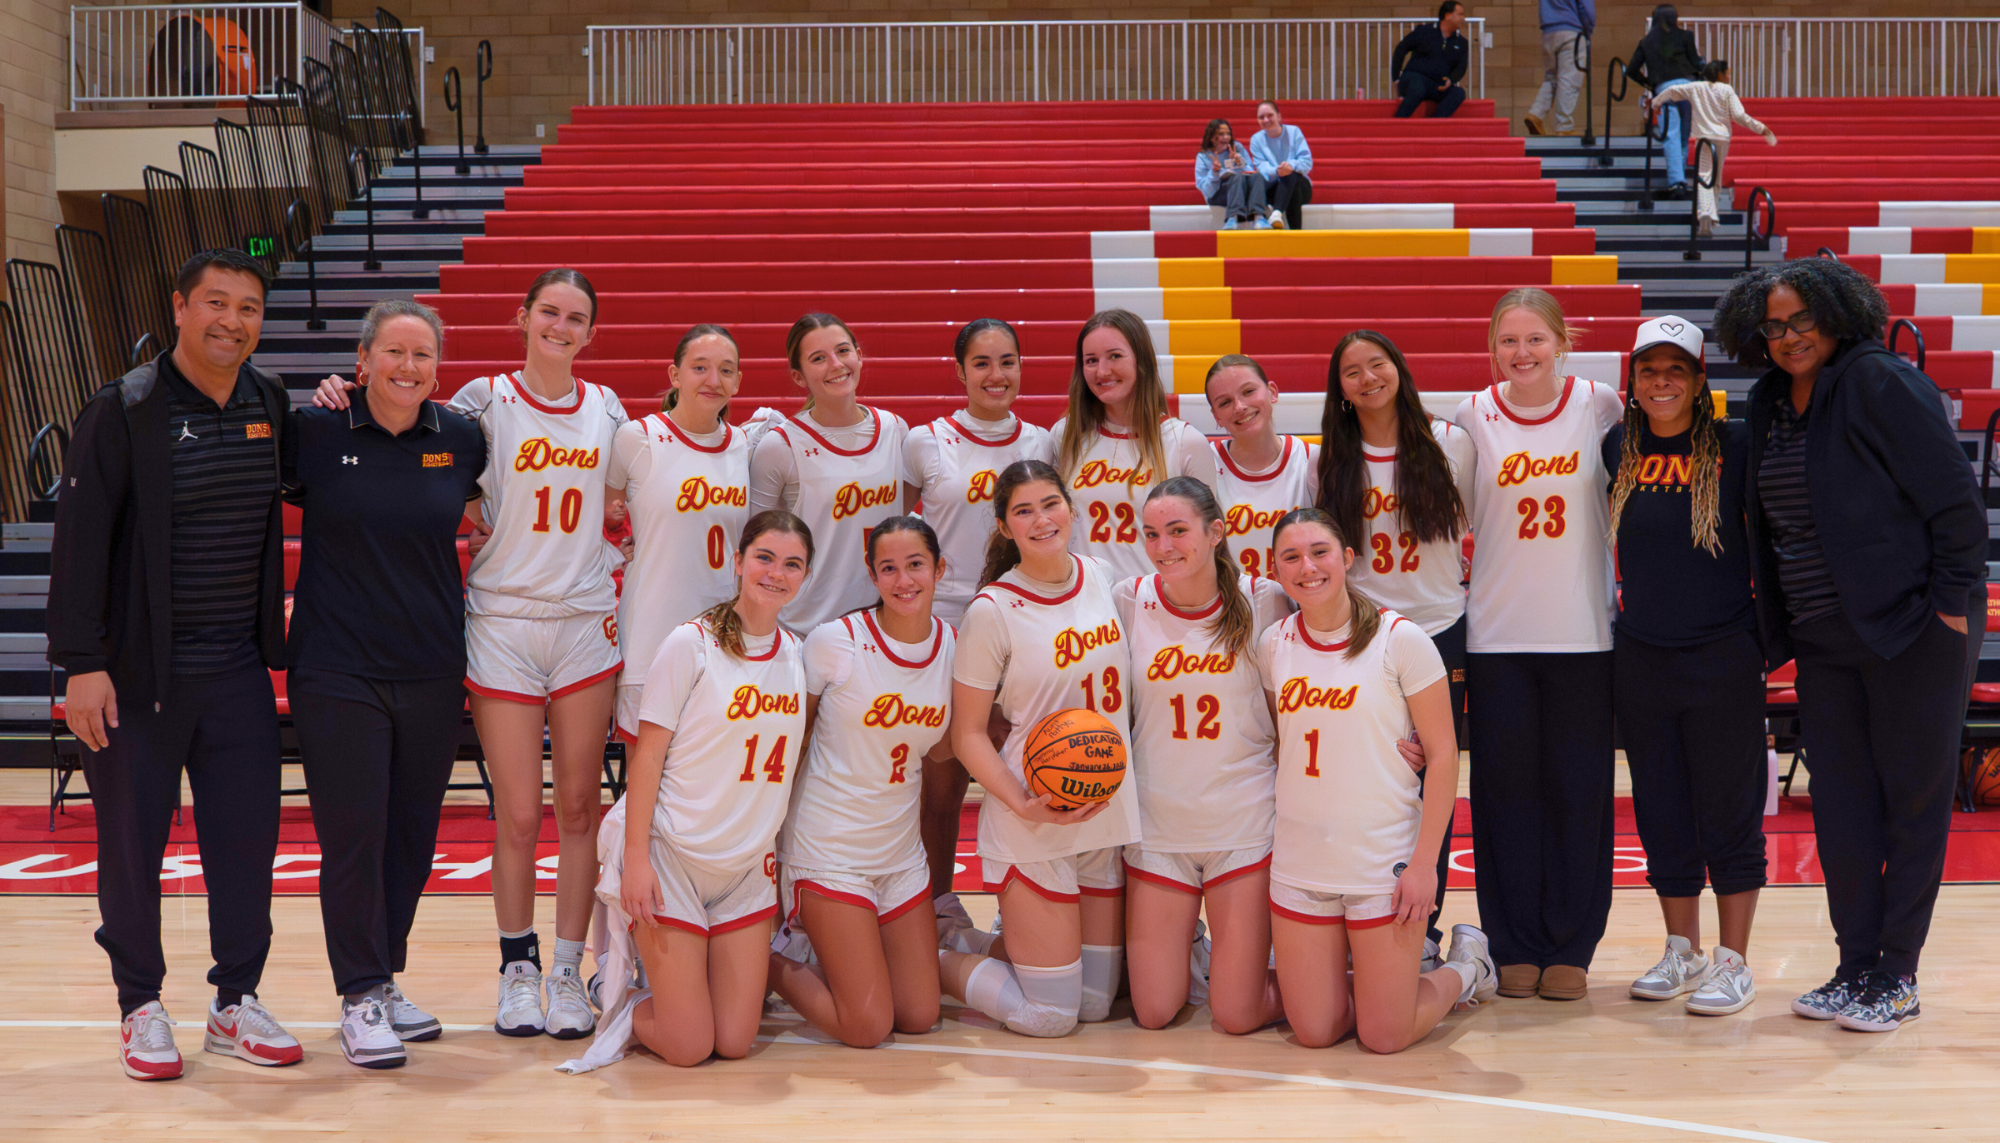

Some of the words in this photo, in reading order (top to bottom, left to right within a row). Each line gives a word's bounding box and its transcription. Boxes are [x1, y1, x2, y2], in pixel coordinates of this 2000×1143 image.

[422, 452, 448, 463] DONS
[514, 436, 600, 473] Dons
[1497, 450, 1580, 488] Dons
[532, 485, 583, 534] 10
[676, 476, 747, 513] Dons
[832, 479, 897, 522] Dons
[1088, 500, 1137, 544] 22
[1225, 504, 1300, 537] Don
[1517, 494, 1566, 539] 23
[707, 524, 725, 570] 0
[1370, 530, 1420, 575] 32
[1054, 618, 1121, 670] Dons
[1147, 644, 1236, 681] Dons
[726, 684, 800, 722] Dons
[1080, 666, 1122, 713] 13
[1278, 676, 1360, 713] Dons
[863, 692, 947, 730] Dons
[1169, 693, 1221, 740] 12
[739, 734, 788, 784] 14
[1068, 734, 1123, 749] DEDICATION
[1084, 745, 1114, 759] GAME
[1304, 728, 1320, 778] 1
[889, 742, 909, 784] 2
[1061, 776, 1121, 798] Wilson
